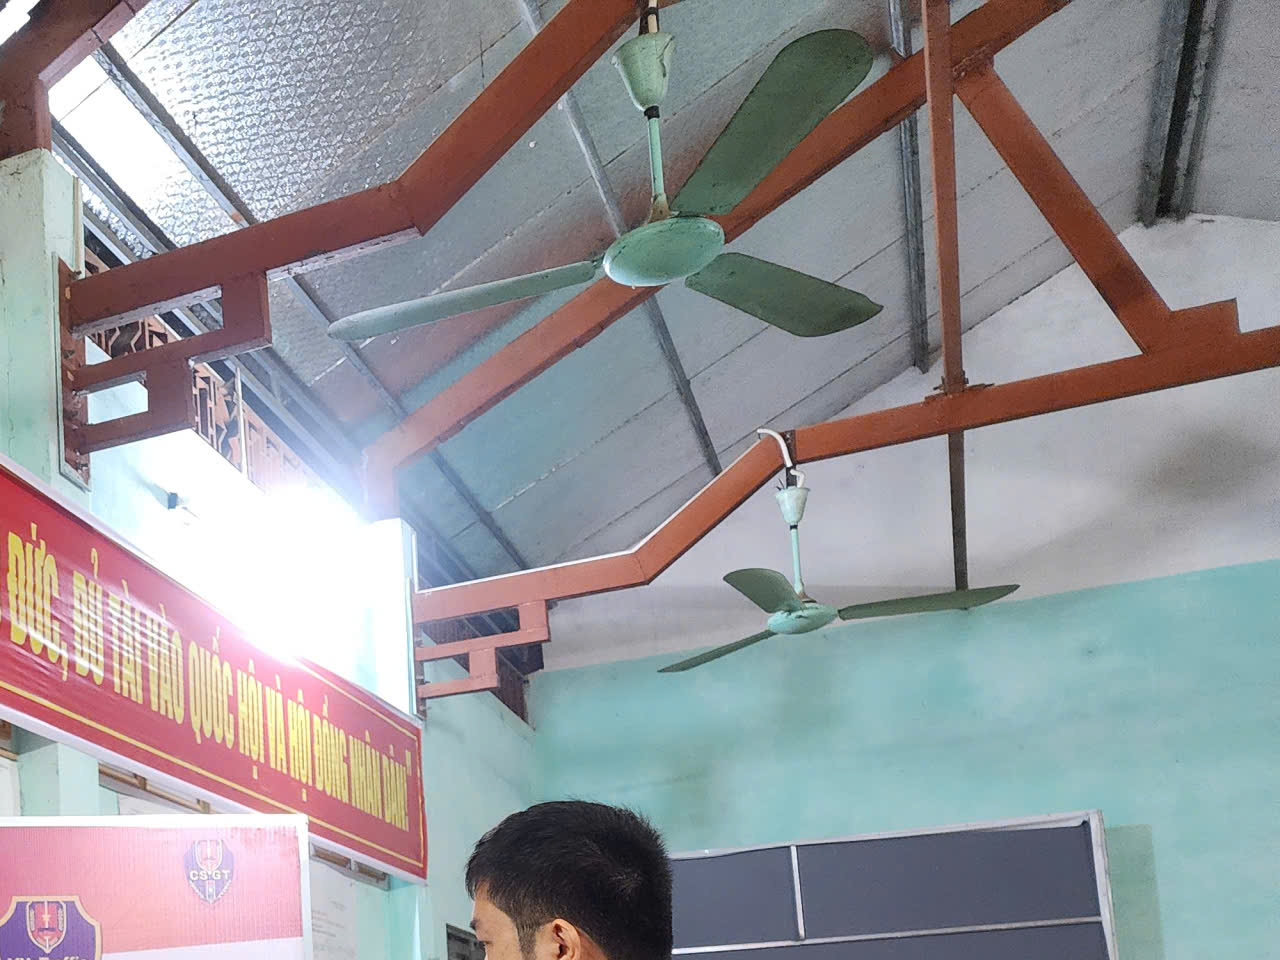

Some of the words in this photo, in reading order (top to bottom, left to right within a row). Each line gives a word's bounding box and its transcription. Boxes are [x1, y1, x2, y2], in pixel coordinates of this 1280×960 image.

[7, 522, 68, 681] ĐỨC,
[73, 548, 104, 685] ĐỦ
[108, 579, 143, 704] TÀI
[146, 604, 185, 724] VÀO
[189, 626, 234, 749] QUỐC
[237, 659, 265, 779] HỘI
[266, 675, 287, 774] VÀ
[288, 689, 312, 801] HỘI
[313, 695, 349, 804] ĐỒNG
[349, 730, 382, 819] NHÂN
